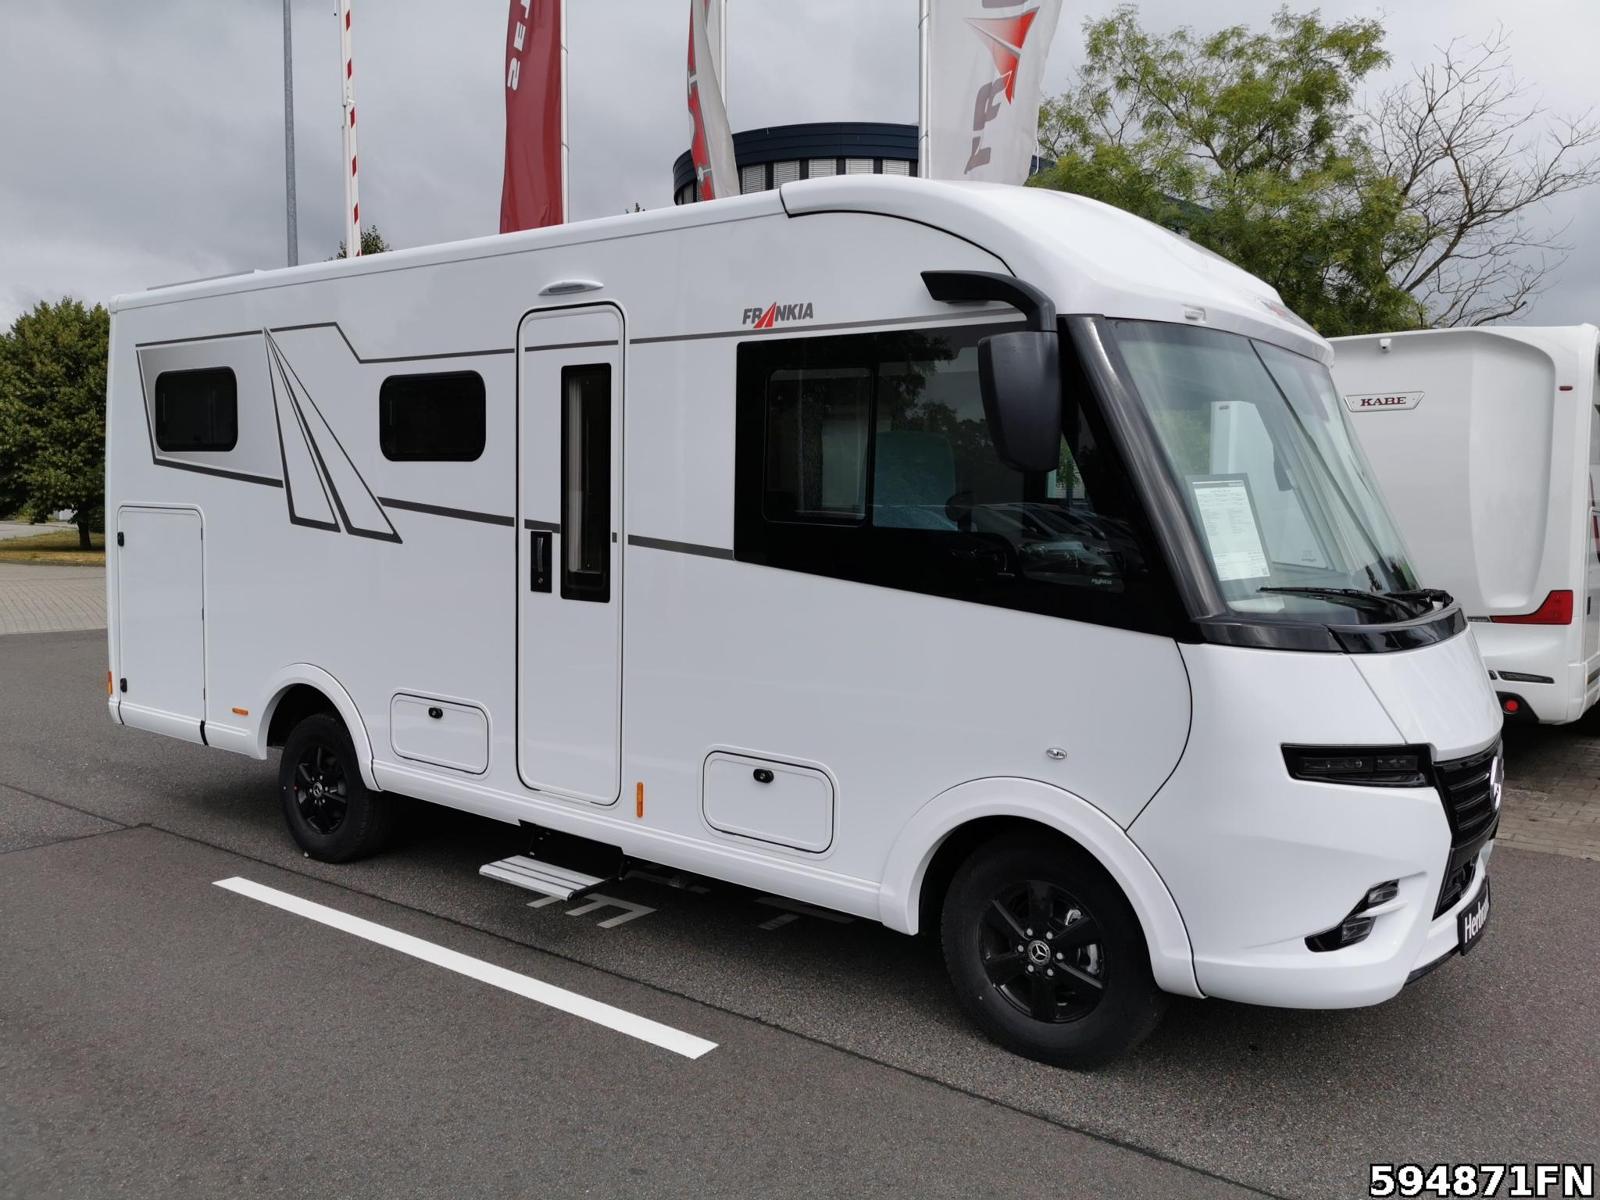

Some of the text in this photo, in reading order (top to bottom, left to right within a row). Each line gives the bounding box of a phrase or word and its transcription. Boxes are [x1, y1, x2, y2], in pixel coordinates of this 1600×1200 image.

[964, 0, 1040, 174] FRA
[742, 302, 813, 328] FRANKIA
[1360, 397, 1406, 406] KABE
